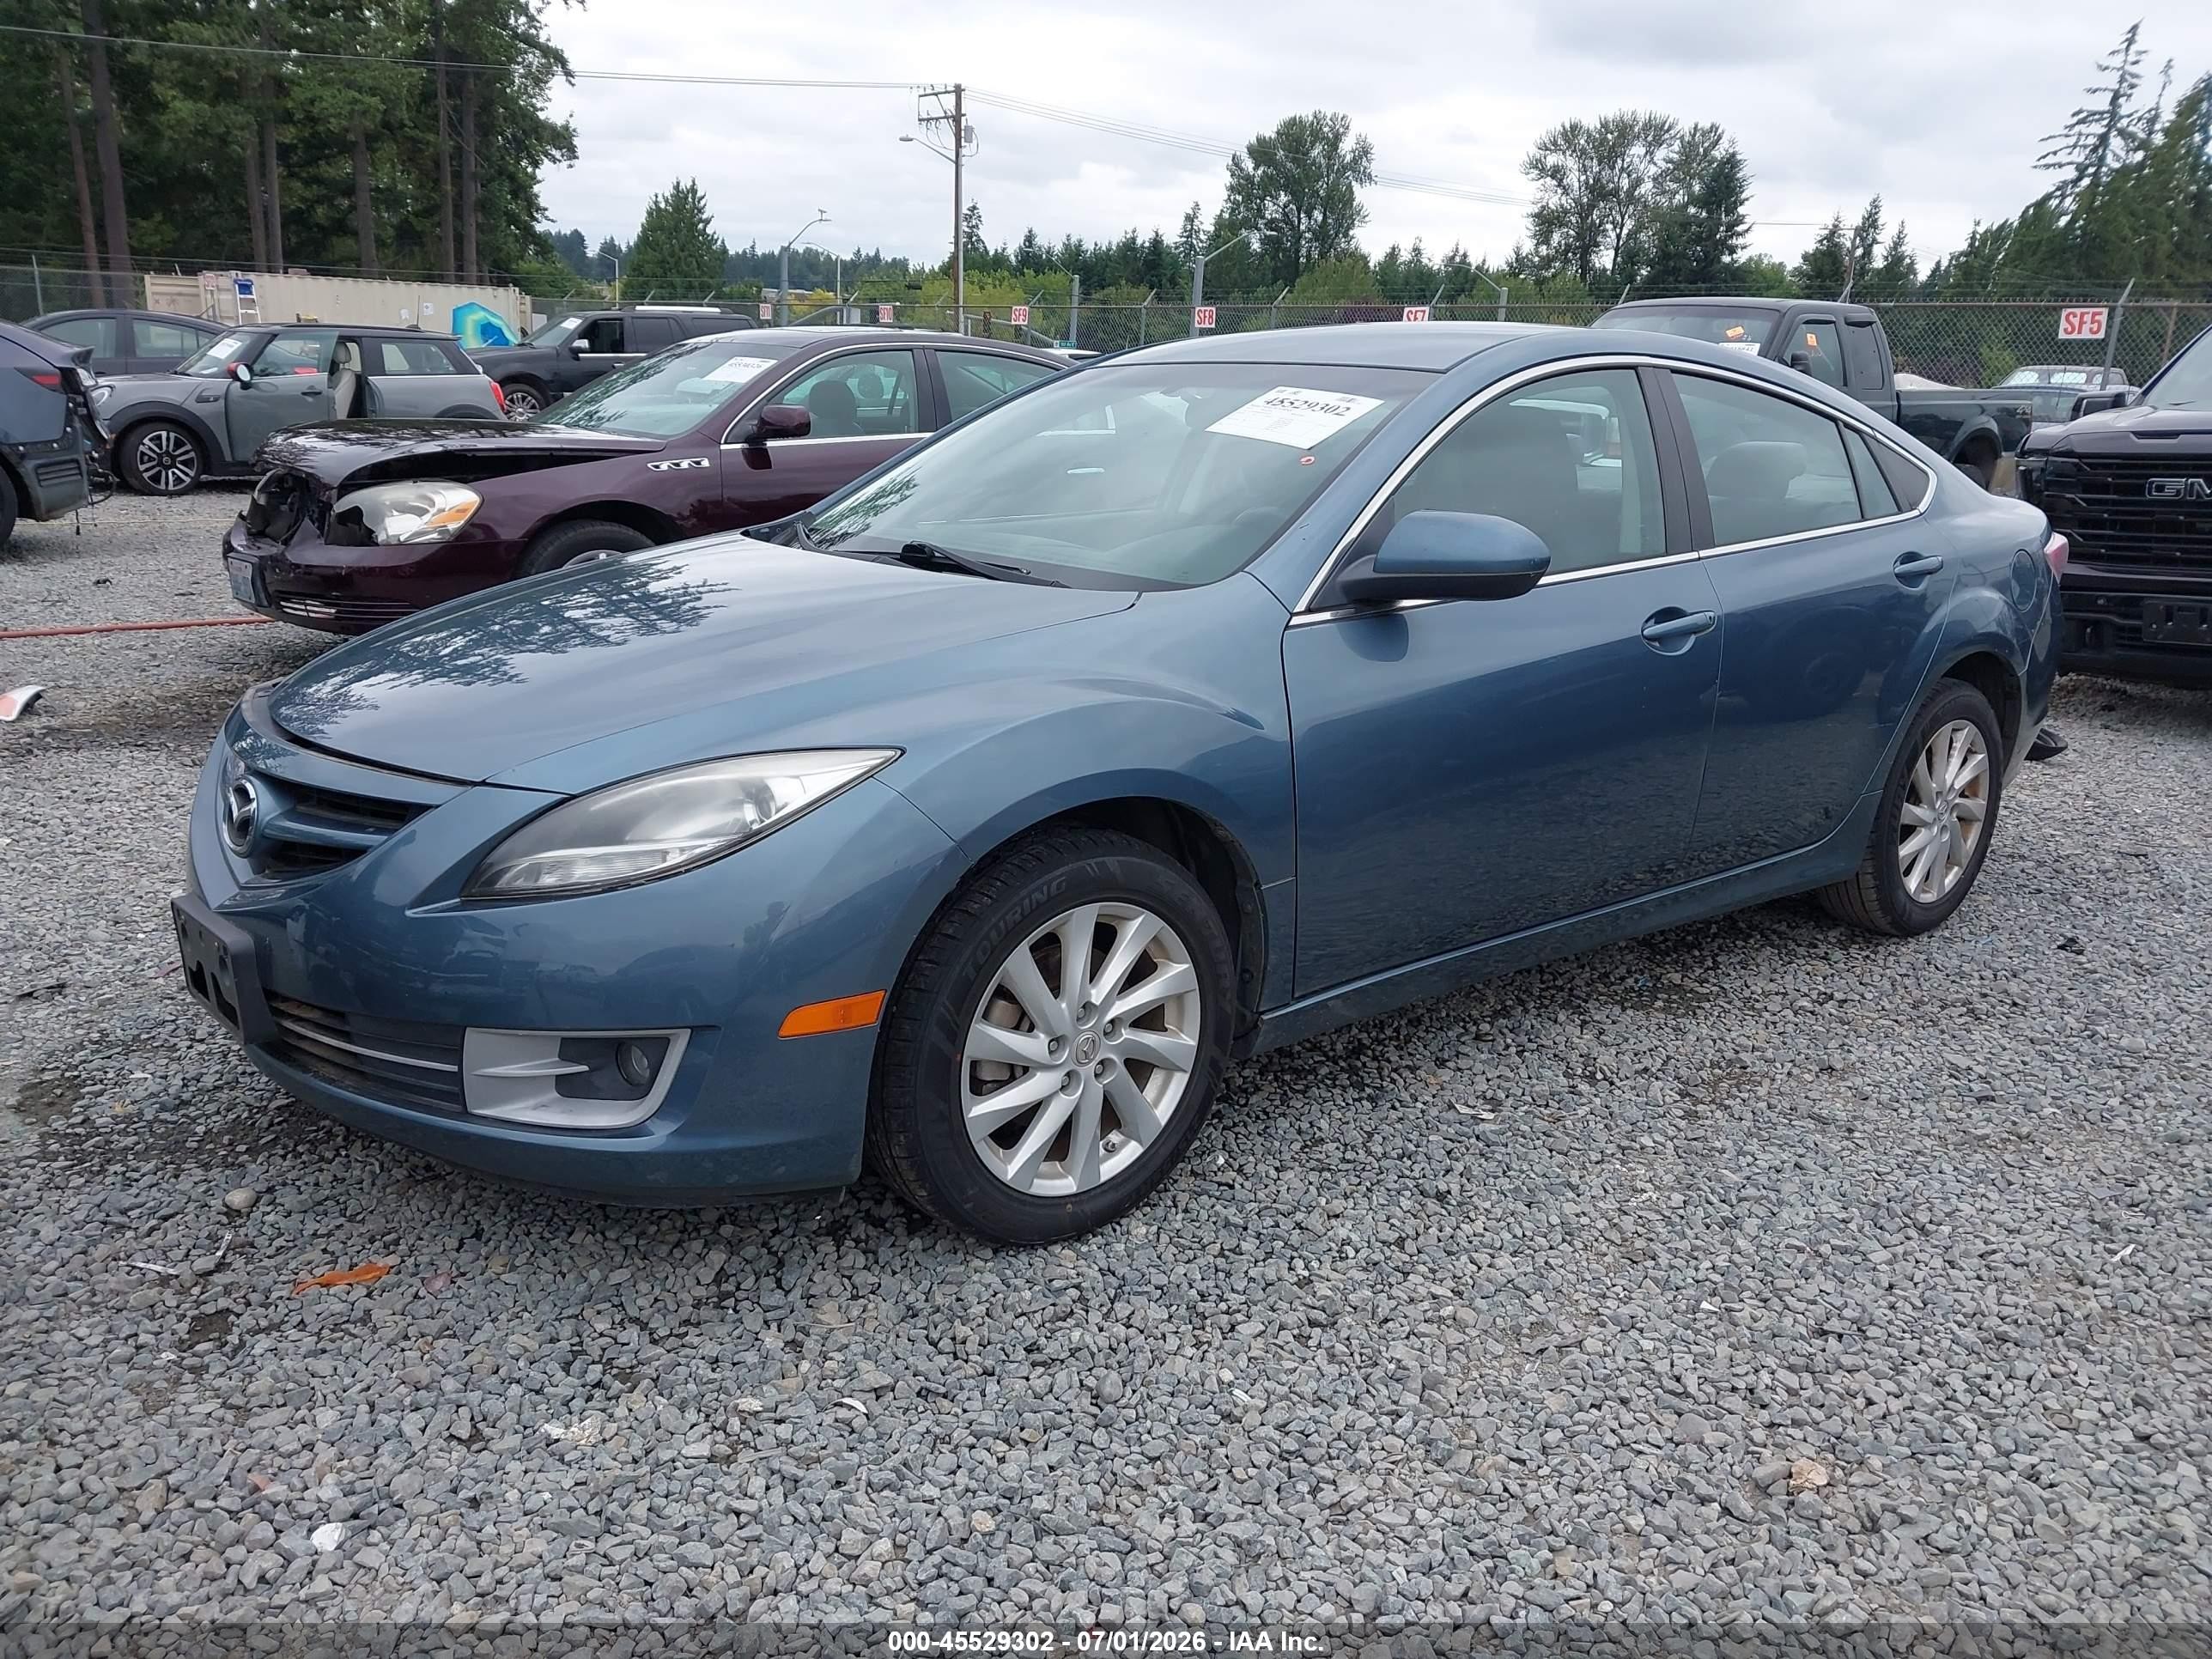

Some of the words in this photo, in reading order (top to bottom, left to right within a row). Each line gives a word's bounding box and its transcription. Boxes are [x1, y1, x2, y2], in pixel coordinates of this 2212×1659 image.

[879, 306, 893, 322] SF10
[1012, 308, 1028, 323] SF9
[1196, 309, 1214, 325] SF8
[2063, 311, 2104, 336] SF5
[1264, 397, 1352, 416] 45529302
[2146, 477, 2212, 500] GM
[963, 875, 1067, 983] TOURING
